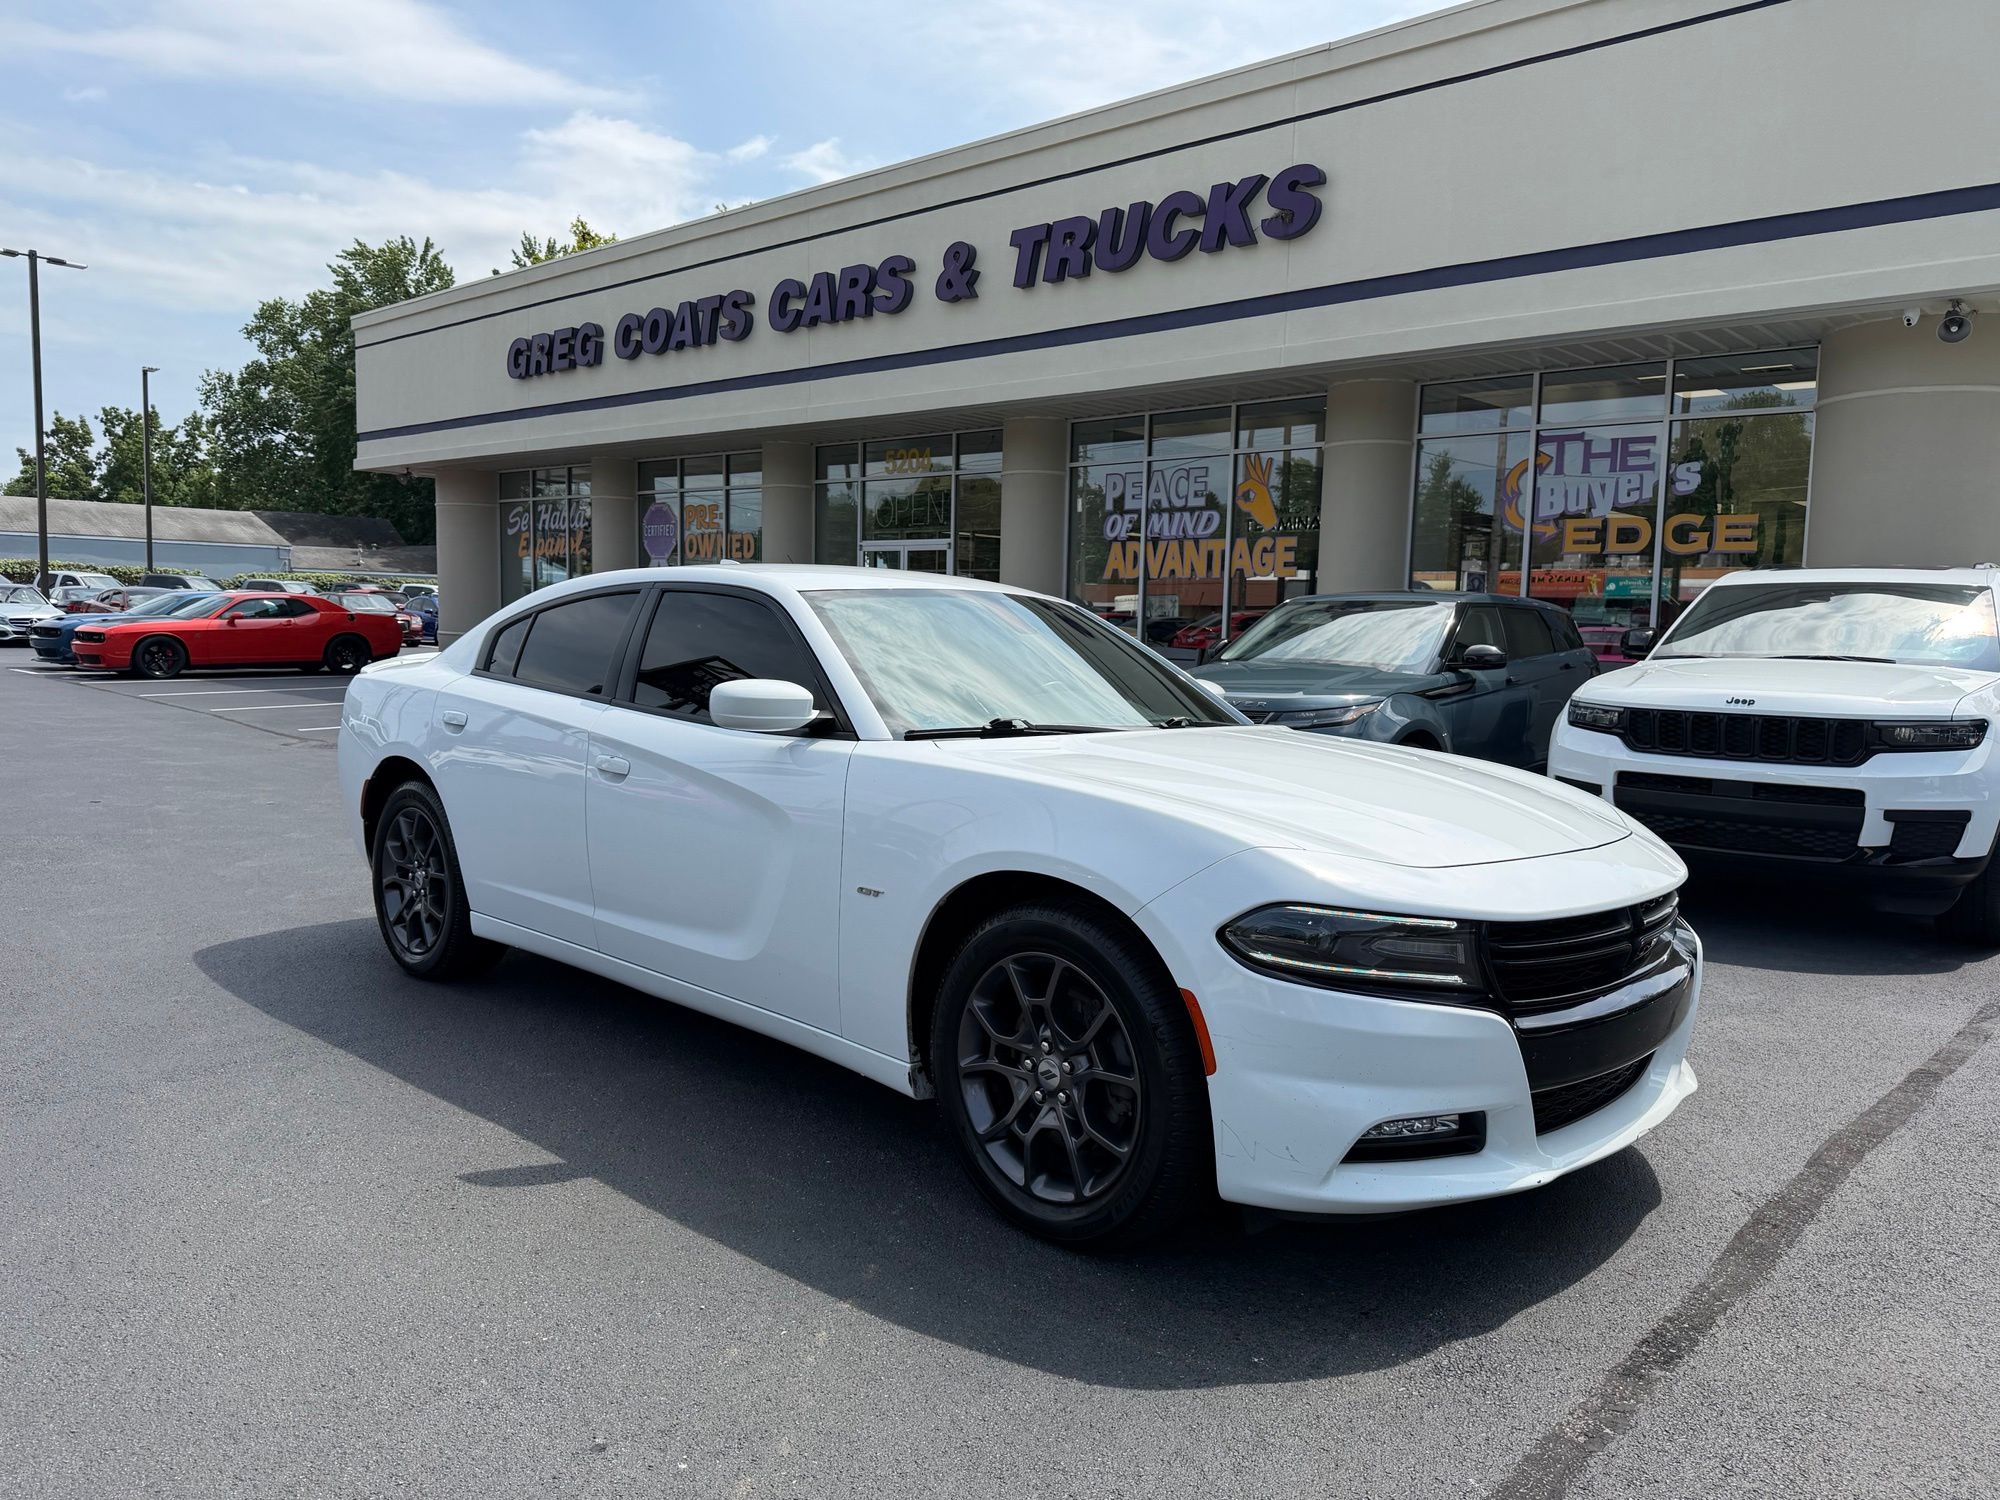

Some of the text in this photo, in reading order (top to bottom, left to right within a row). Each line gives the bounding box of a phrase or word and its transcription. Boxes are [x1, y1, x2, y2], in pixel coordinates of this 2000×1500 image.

[507, 163, 1327, 381] GREG COATS CARS & TRUCKS
[884, 446, 933, 475] 5204
[1537, 431, 1657, 477] THE
[1105, 467, 1209, 511] PEACE
[507, 506, 530, 536] Se
[875, 492, 947, 527] OPEN
[1103, 509, 1220, 541] OF MIND
[518, 528, 588, 558] Epañl
[644, 524, 675, 537] CERTIFIED
[1562, 513, 1760, 555] EDGE
[1103, 536, 1298, 580] ADVANTAGE
[1726, 696, 1756, 706] Jeep
